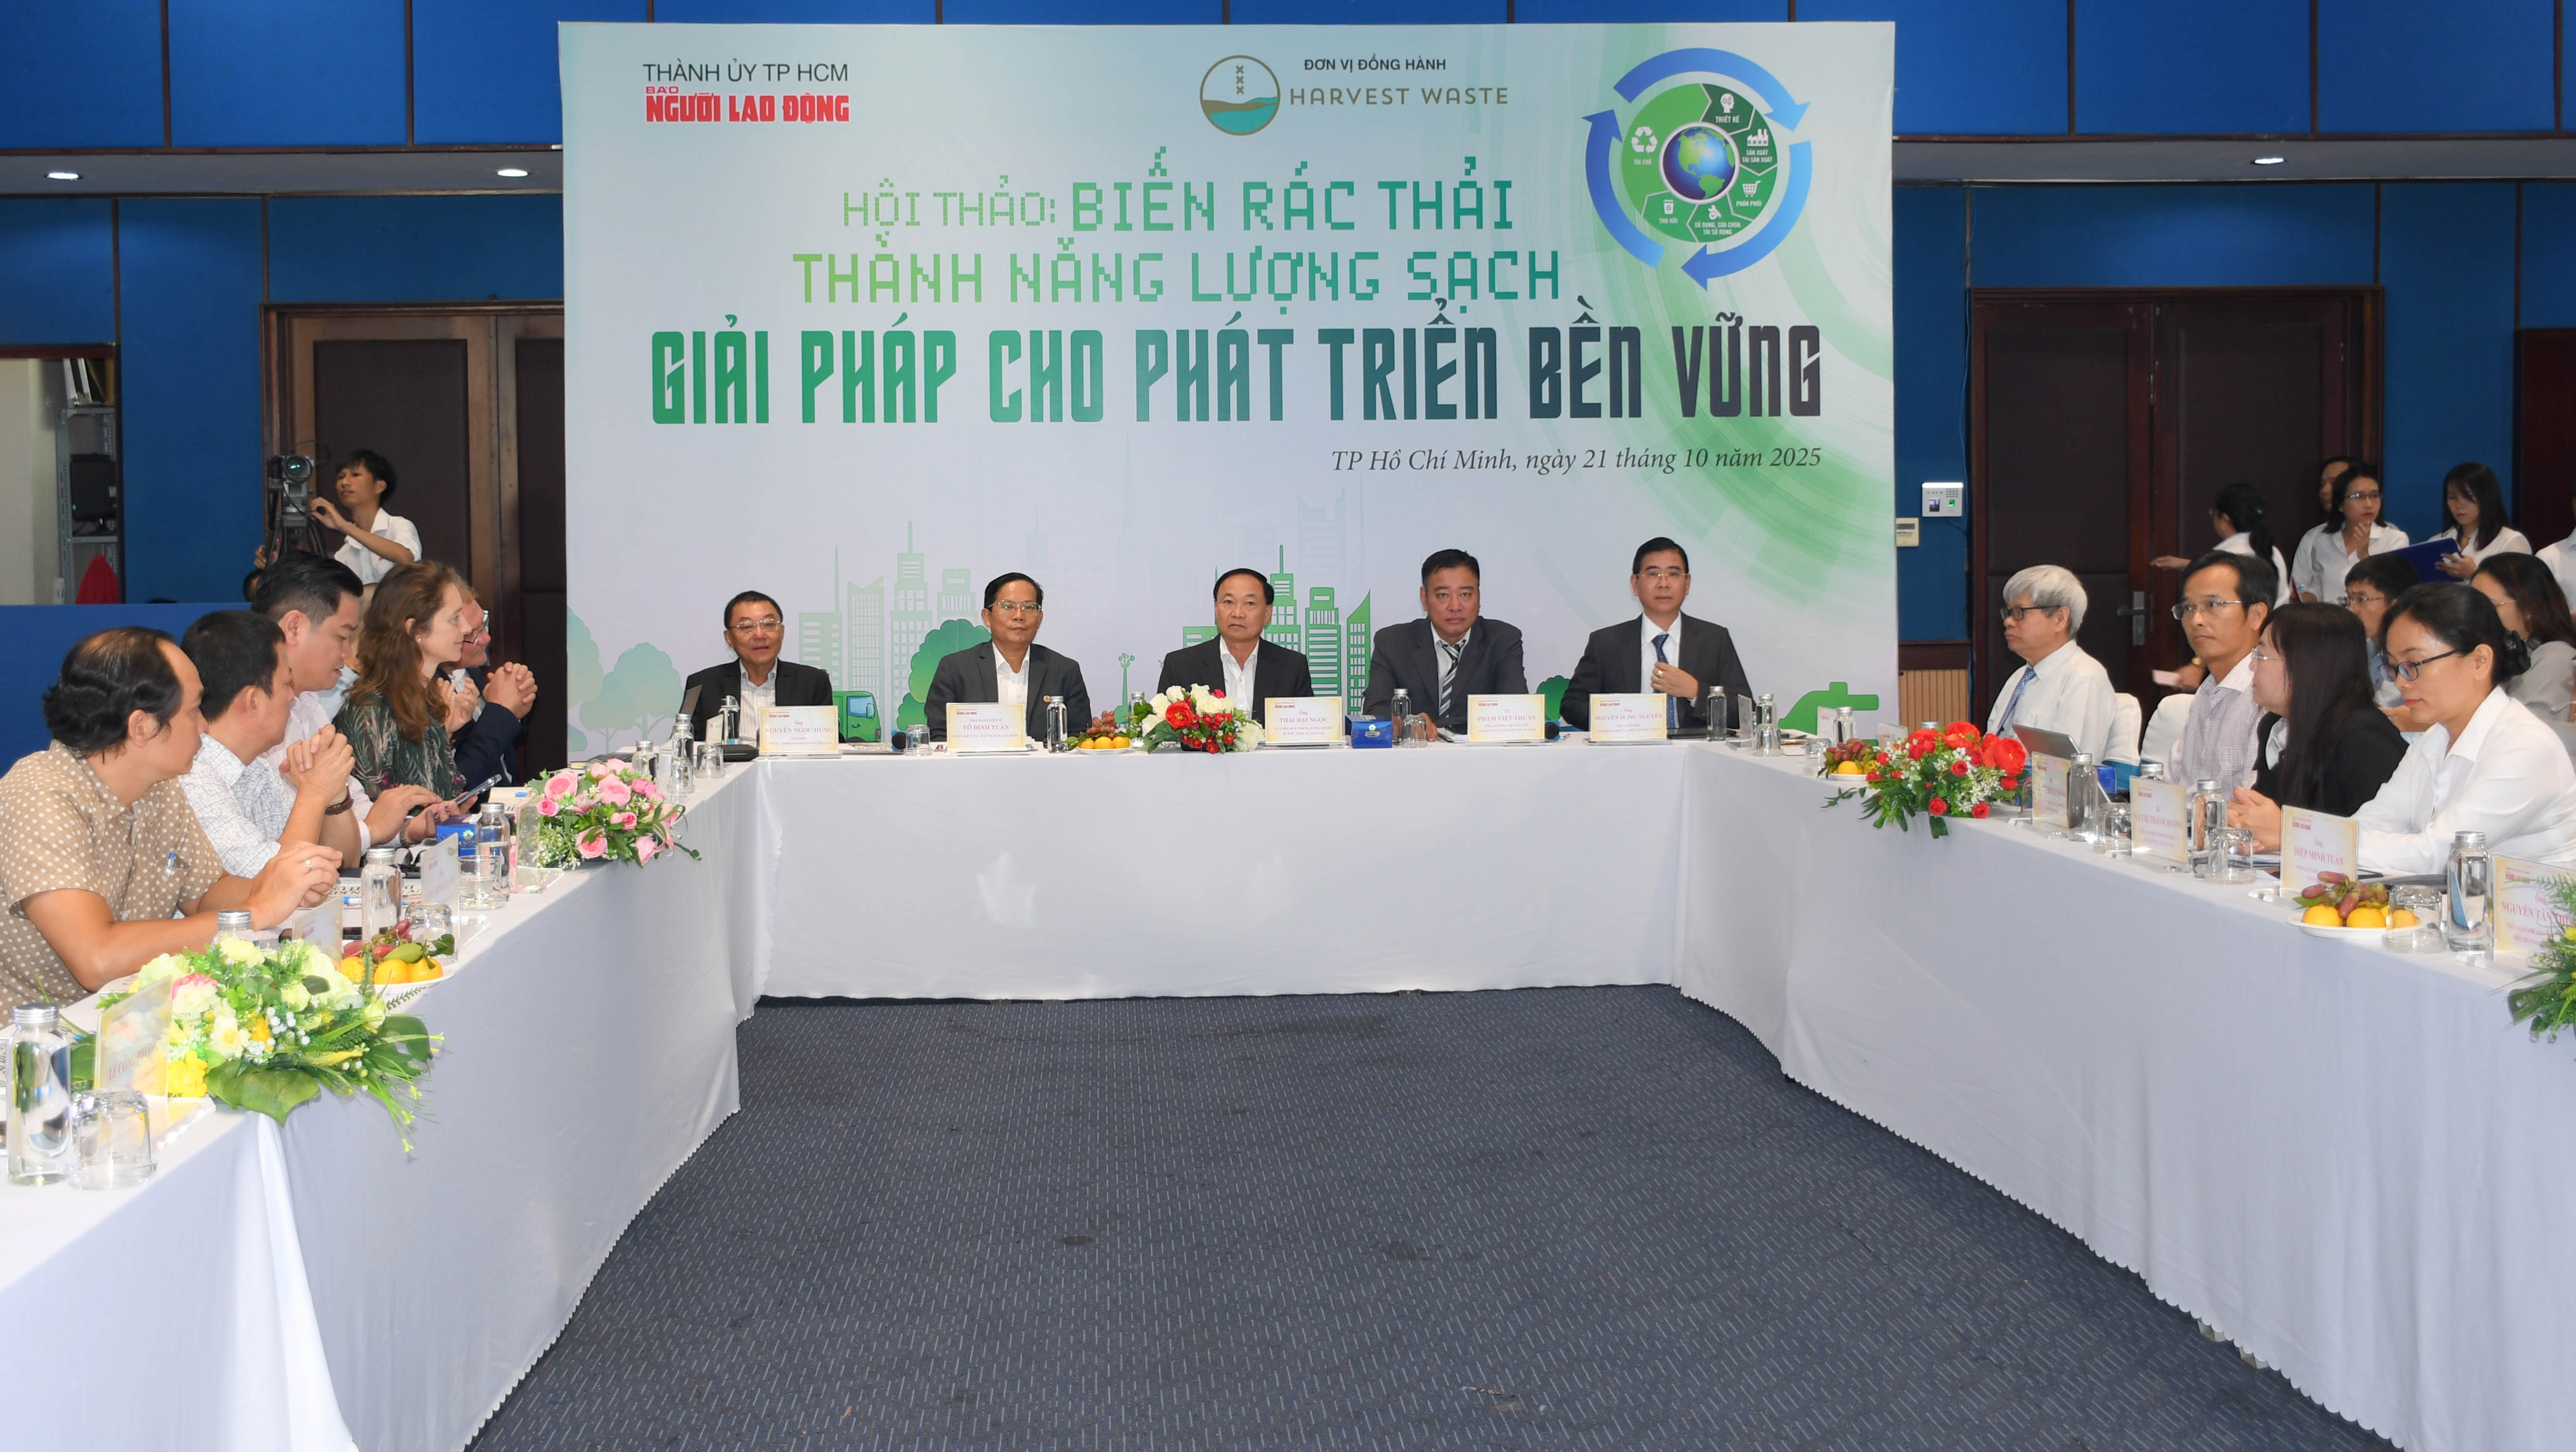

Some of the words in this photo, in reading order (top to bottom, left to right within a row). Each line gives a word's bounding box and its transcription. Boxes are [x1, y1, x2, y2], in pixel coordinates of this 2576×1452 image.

[643, 58, 719, 82] THÀNH
[728, 58, 756, 82] ỦY
[762, 64, 790, 81] TP
[798, 63, 847, 82] HCM
[1304, 58, 1335, 70] ĐƠN
[1341, 59, 1352, 73] VỊ
[1358, 54, 1400, 70] ĐỒNG
[1406, 56, 1446, 70] HÀNH
[646, 91, 721, 122] NGƯỜI
[729, 95, 775, 122] LAO
[782, 92, 849, 123] ĐỘNG
[1290, 88, 1409, 105] HARVEST
[1421, 87, 1508, 105] WASTE
[1733, 114, 1740, 123] KẾ
[844, 178, 920, 236] HỘI
[933, 175, 1056, 226] THẢO:
[1073, 146, 1214, 232] BIẾN
[1243, 161, 1354, 230] RÁC
[1378, 156, 1512, 229] THẢI
[793, 234, 982, 303] THÀNH
[1010, 237, 1163, 303] NĂNG
[1192, 246, 1379, 314] LƯỢNG
[1407, 251, 1558, 313] SẠCH
[652, 314, 769, 424] GIẢI
[801, 313, 956, 424] PHÁP
[989, 330, 1103, 423] CHO
[1136, 310, 1294, 422] PHÁT
[1318, 298, 1497, 420] TRIỂN
[1529, 296, 1641, 419] BỀN
[1675, 312, 1820, 418] VỮNG
[1332, 451, 1362, 470] TP
[1369, 449, 1401, 470] Hồ
[1409, 449, 1447, 470] Chí
[1453, 449, 1516, 471] Minh,
[1526, 449, 1576, 475] ngày
[1582, 450, 1605, 468] 21
[1617, 447, 1677, 474] tháng
[1684, 449, 1708, 467] 10
[1716, 448, 1762, 466] năm
[1769, 448, 1820, 466] 2025
[2294, 846, 2308, 859] DIỆP
[2309, 850, 2325, 861] MINH
[2502, 901, 2534, 918] NGUYỄN
